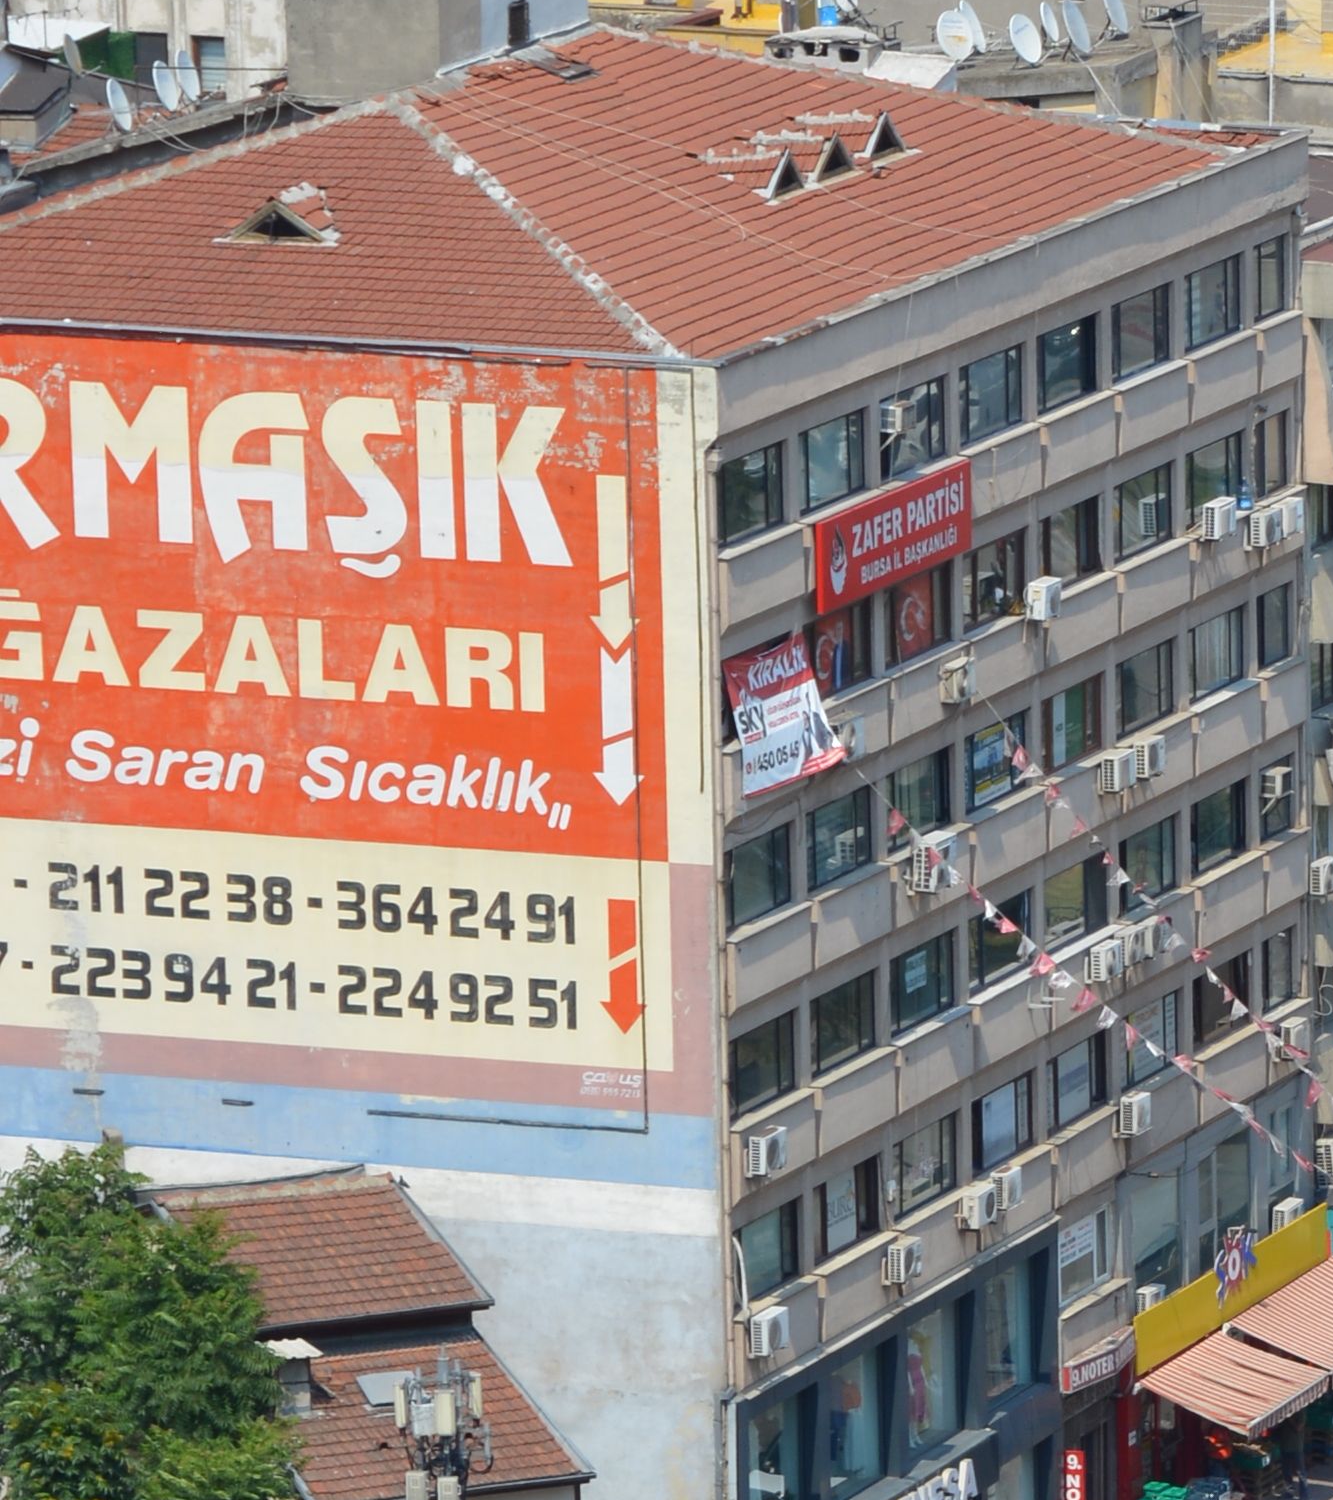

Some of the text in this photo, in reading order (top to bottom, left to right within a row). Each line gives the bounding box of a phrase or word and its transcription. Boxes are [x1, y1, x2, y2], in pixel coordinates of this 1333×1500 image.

[851, 471, 964, 558] ZAFER PARTİSİ
[861, 523, 958, 584] BURSA İL BAŞKANLIĞI
[738, 703, 767, 738] SKY
[65, 729, 265, 794] Saran
[47, 861, 577, 945] 211 22 38 364 24 91
[49, 944, 579, 1030] 223 94 21 224 92 51
